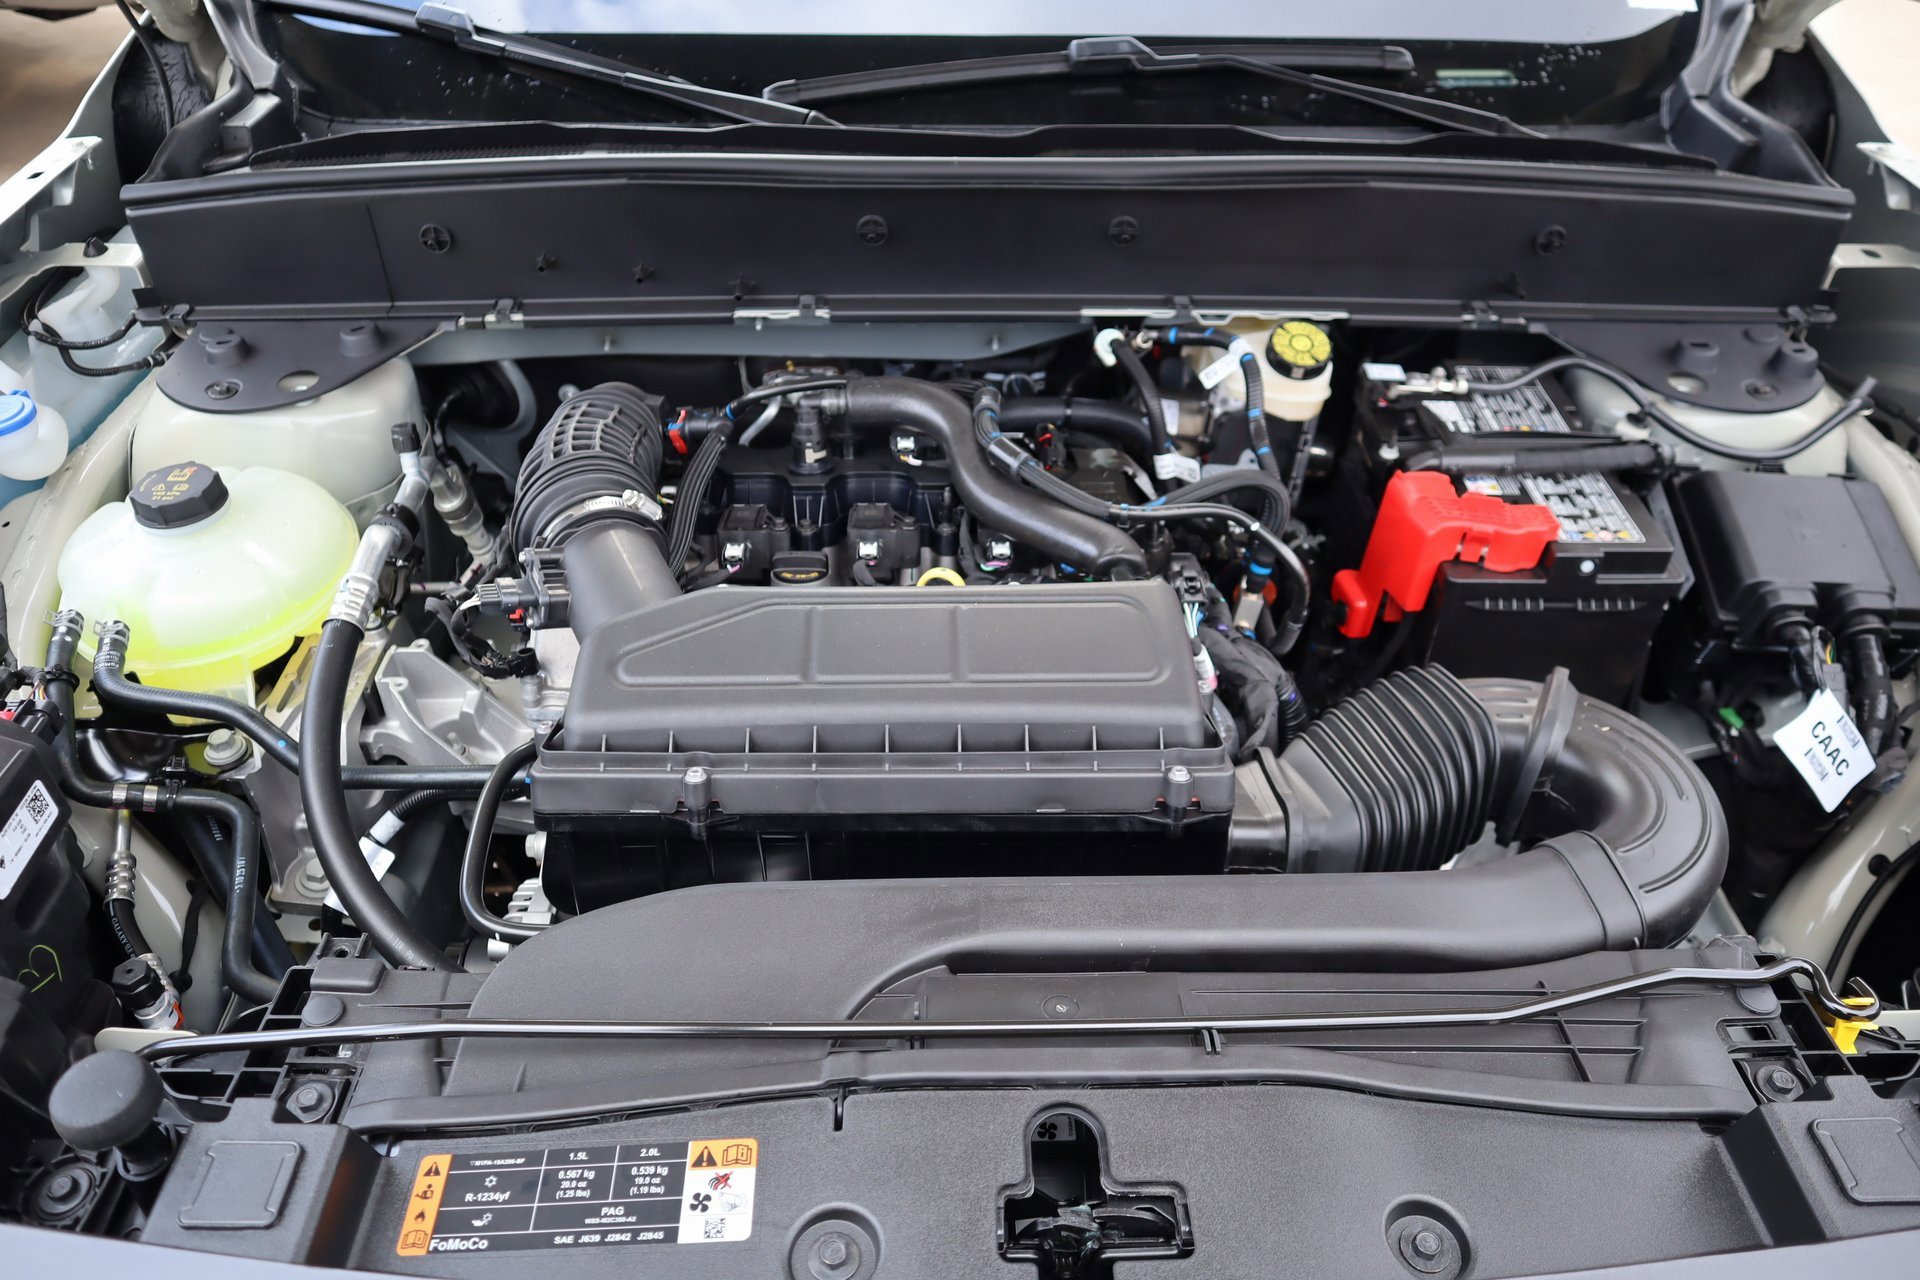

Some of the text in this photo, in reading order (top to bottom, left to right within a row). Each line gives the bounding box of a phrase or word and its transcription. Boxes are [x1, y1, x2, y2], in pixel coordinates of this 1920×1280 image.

[1811, 721, 1850, 776] CAAC
[111, 917, 129, 944] GALAXY
[568, 1151, 589, 1161] 1.5L
[639, 1147, 661, 1157] 2.0L
[558, 1169, 596, 1180] 0.567 kg
[631, 1165, 669, 1176] 0.539 kg
[556, 1189, 591, 1199] (1.25 lbs)
[629, 1186, 665, 1196] (1.19 lbs)
[464, 1191, 512, 1203] R-1234yf
[601, 1206, 624, 1216] PAG
[553, 1231, 664, 1244] SAE J639 J2842 J2845
[428, 1237, 488, 1251] FoMoCo
